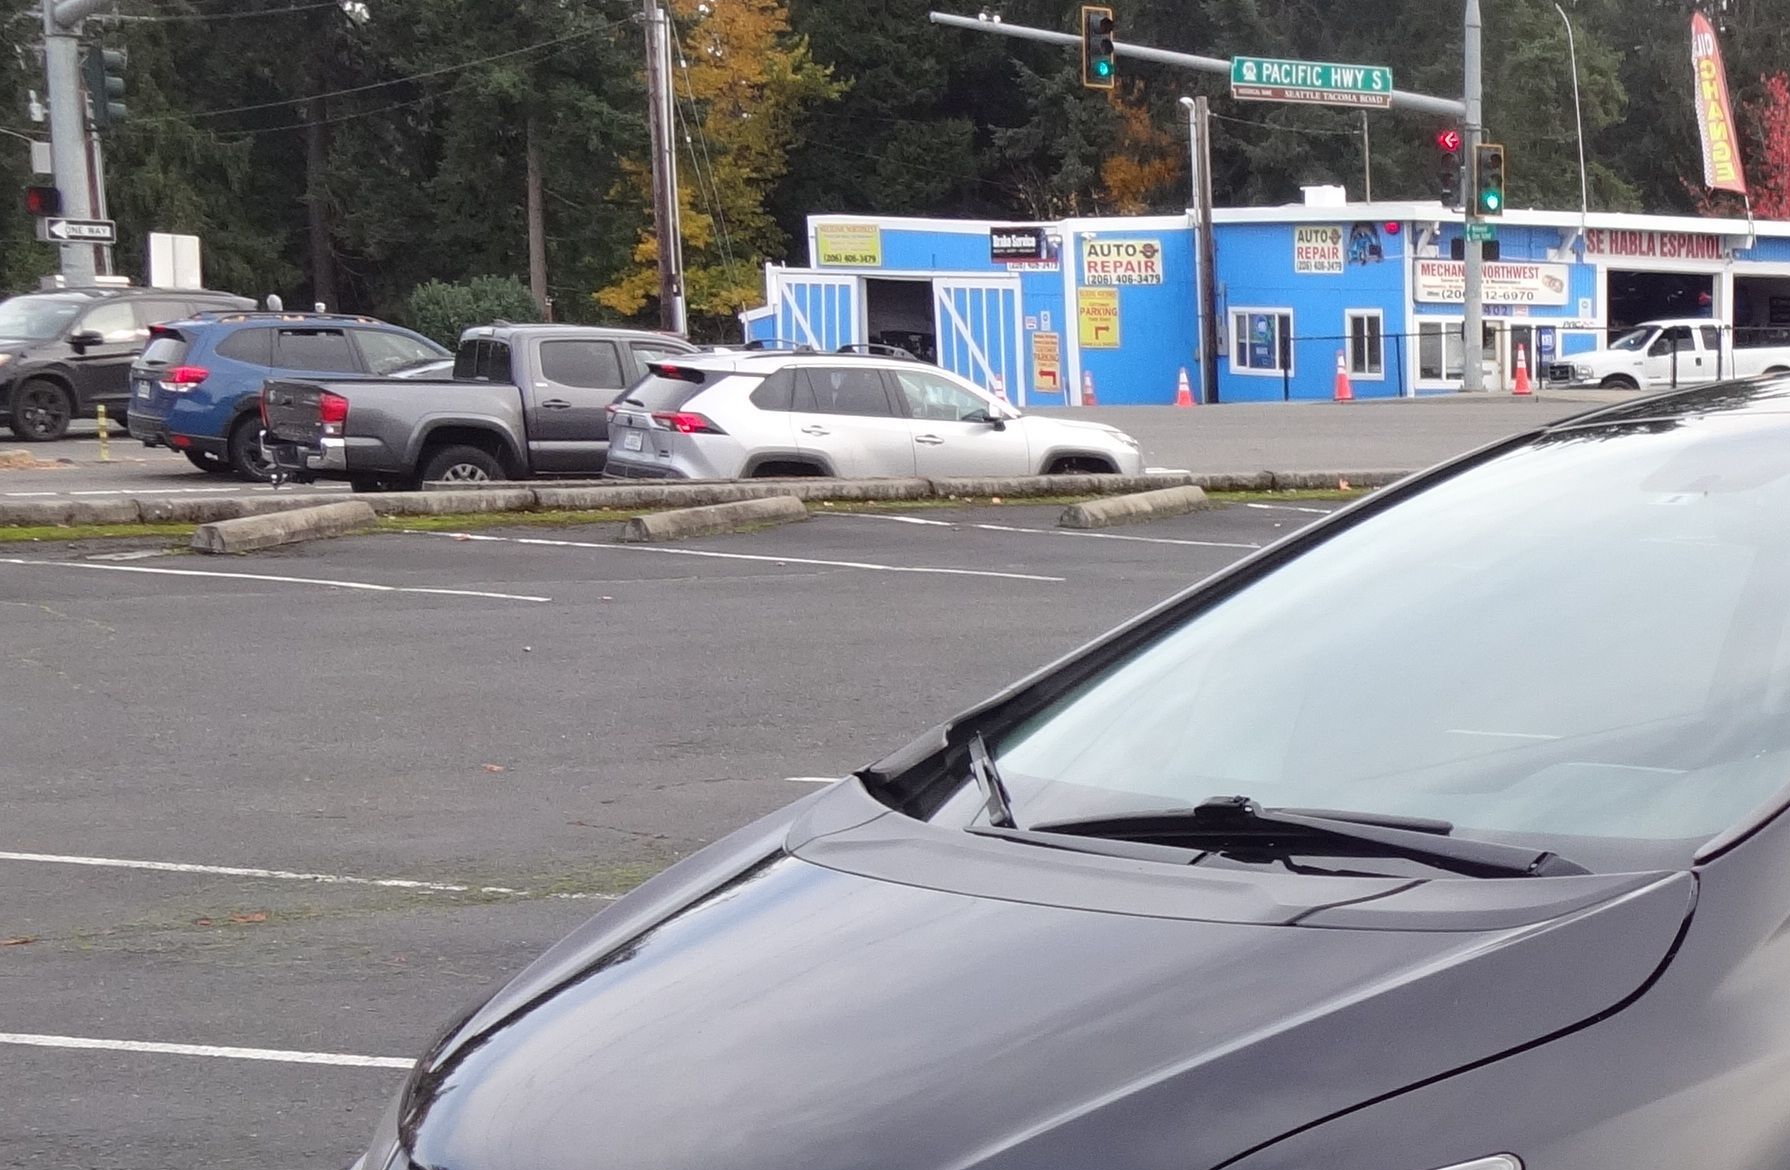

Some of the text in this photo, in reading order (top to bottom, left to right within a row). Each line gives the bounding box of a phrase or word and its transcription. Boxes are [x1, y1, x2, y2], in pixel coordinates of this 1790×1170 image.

[1262, 62, 1382, 90] PACIFIC HWY S
[1284, 89, 1383, 104] SEATTLE TACOMA ROAD
[66, 226, 107, 235] ONE WAY
[1297, 229, 1328, 243] AUTO
[1586, 229, 1604, 254] SE
[1608, 230, 1656, 257] HABLA
[1087, 244, 1137, 257] AUTO
[1297, 246, 1339, 260] REPAIR
[1087, 260, 1156, 273] REPAIR
[1421, 263, 1466, 277] MECHAN
[1087, 274, 1160, 286] (206) 406-3479
[1441, 290, 1465, 300] (20
[1485, 291, 1534, 301] 12-6970
[1080, 307, 1117, 316] PARKING
